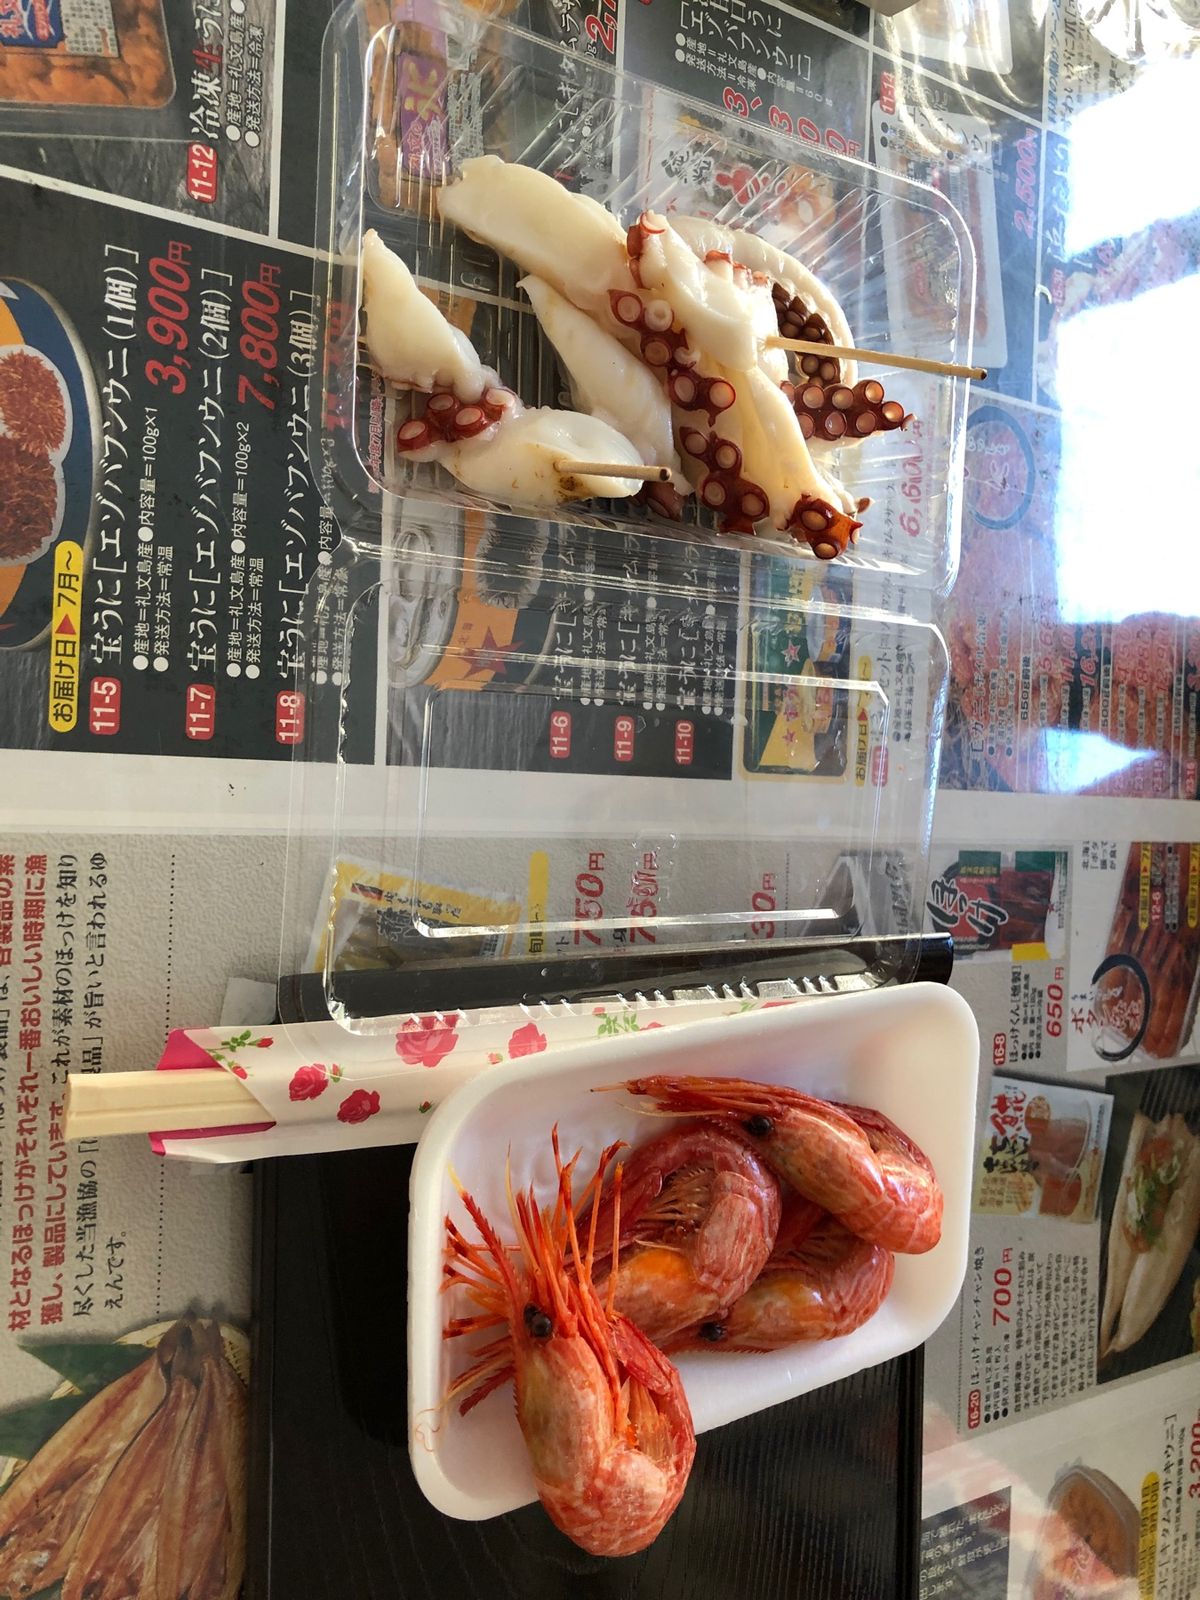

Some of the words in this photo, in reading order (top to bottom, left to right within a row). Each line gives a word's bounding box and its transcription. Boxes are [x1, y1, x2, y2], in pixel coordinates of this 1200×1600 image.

[246, 24, 264, 132] 発送方法＝冷凍
[882, 70, 896, 114] 11-14
[190, 143, 214, 201] 11-12
[144, 240, 192, 395] 3,900円
[237, 262, 282, 411] 7,800円
[153, 545, 174, 656] 発送方法＝常温
[245, 556, 264, 664] 発送方法＝常温
[53, 639, 77, 723] お届け日
[92, 680, 118, 732] 11-5
[189, 686, 212, 737] 11-7
[278, 694, 299, 741] 11-8
[552, 714, 570, 755] 11-6
[616, 718, 632, 759] 11-9
[677, 722, 692, 764] 11-10
[925, 879, 1008, 935] ほっけ
[1046, 966, 1064, 1038] 650円
[994, 1033, 1005, 1065] 16-8
[8, 854, 48, 1332] 材となるほっけがそれぞれ一番おいしい時期に漁
[72, 852, 108, 1317] 尽くした当漁協の「品」が旨いと言われるゆ
[104, 1229, 126, 1310] えんです。
[992, 1246, 1014, 1326] 700円
[969, 1391, 980, 1429] 16-20
